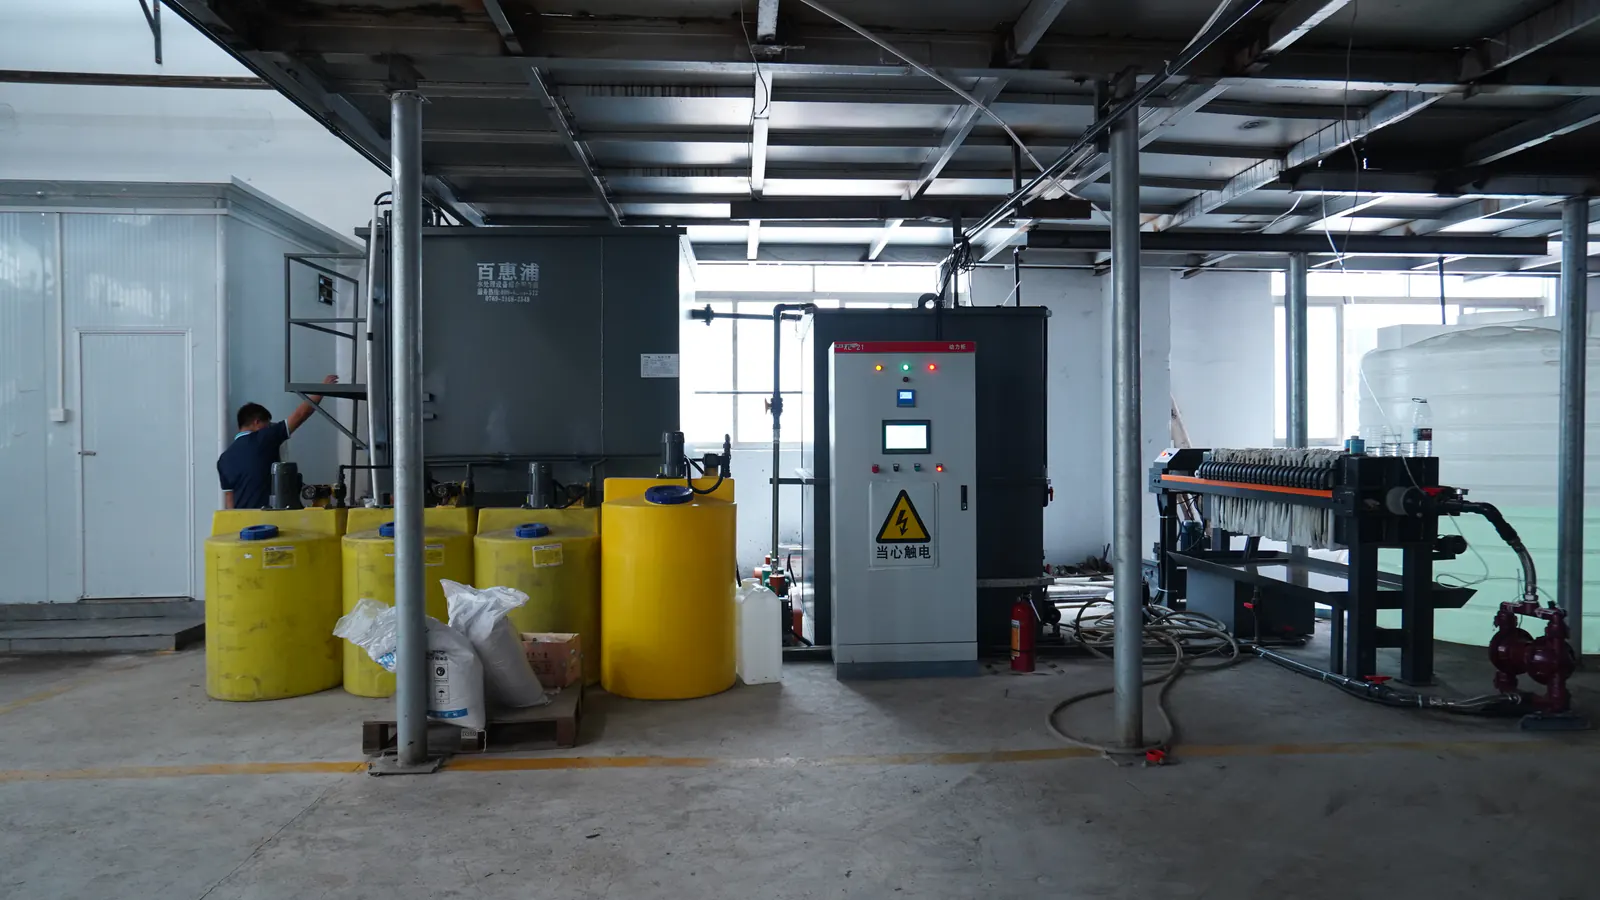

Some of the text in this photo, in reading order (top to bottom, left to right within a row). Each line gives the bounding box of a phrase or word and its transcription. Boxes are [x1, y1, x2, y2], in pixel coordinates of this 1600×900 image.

[477, 262, 539, 281] 百惠浦
[876, 545, 931, 559] 当心触电
